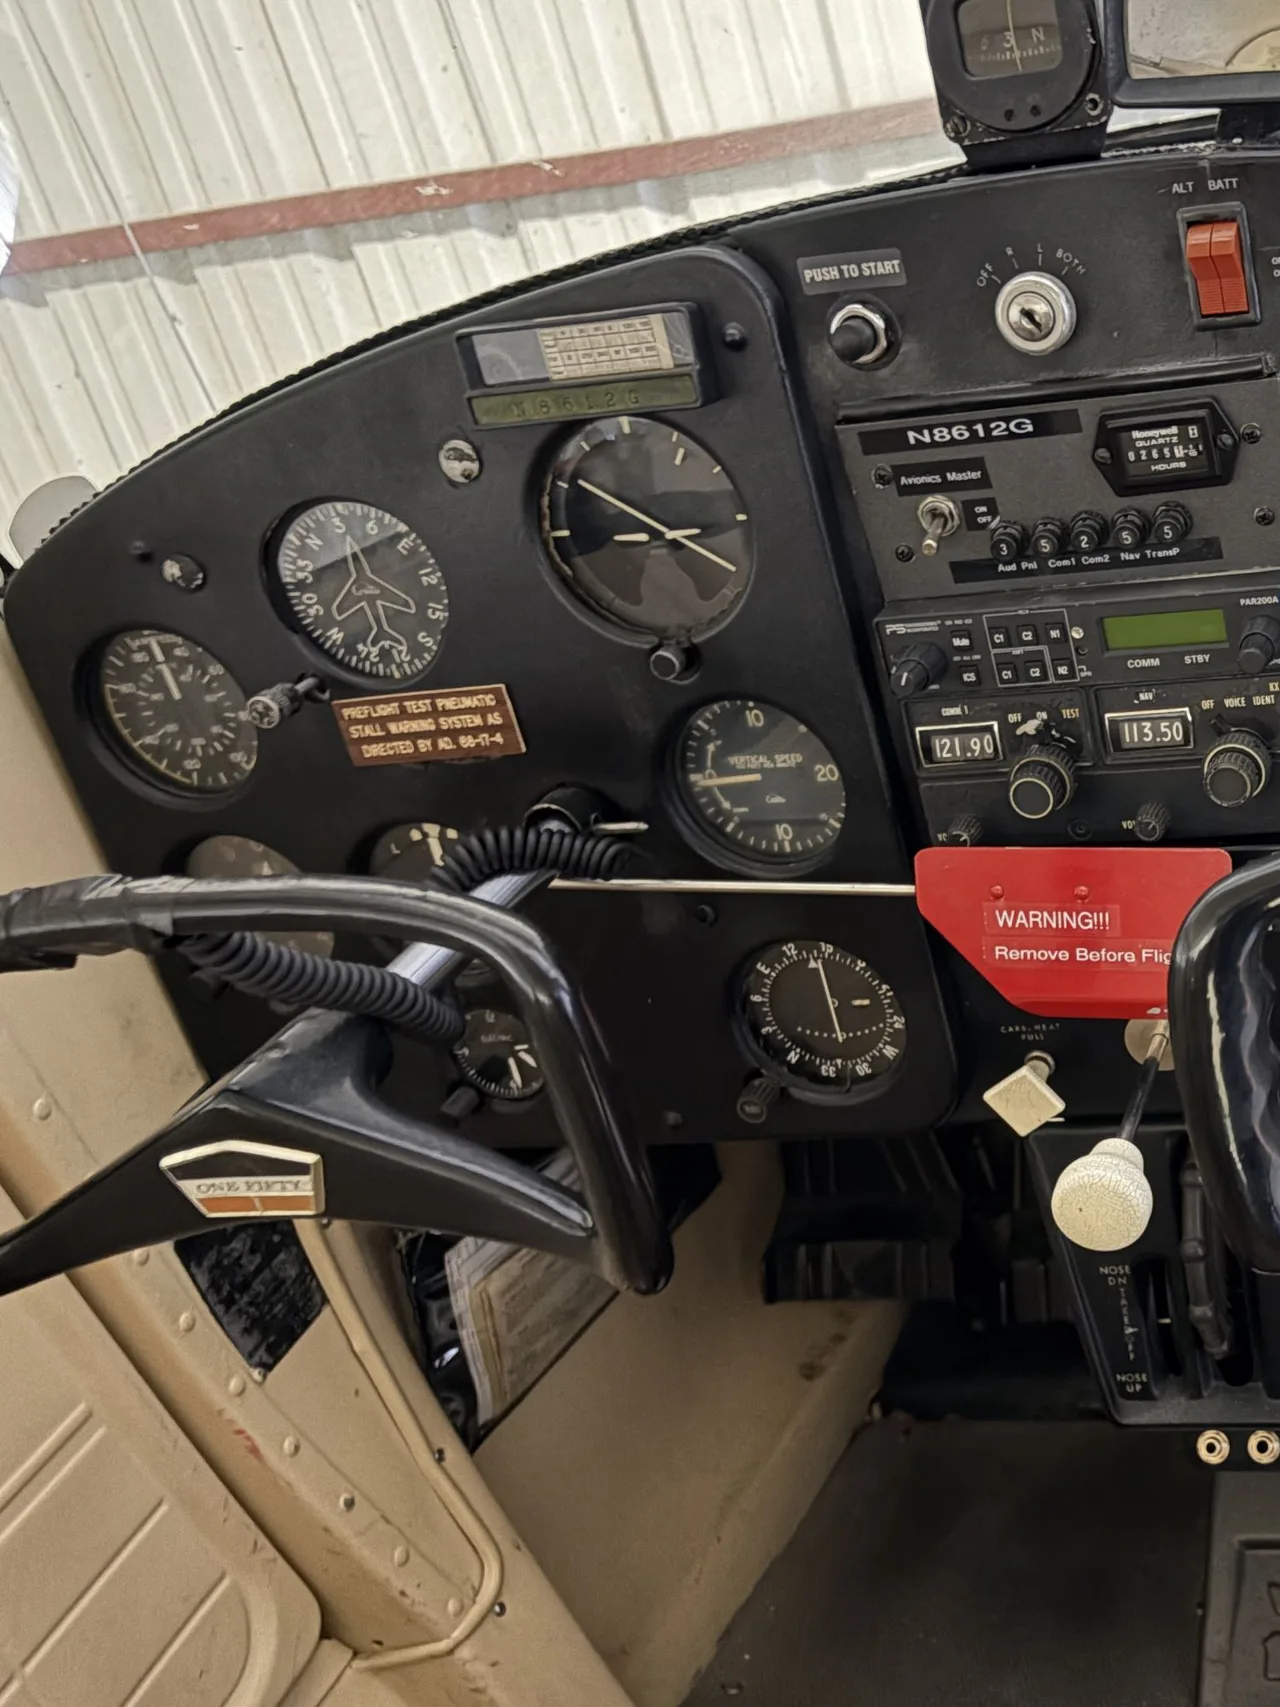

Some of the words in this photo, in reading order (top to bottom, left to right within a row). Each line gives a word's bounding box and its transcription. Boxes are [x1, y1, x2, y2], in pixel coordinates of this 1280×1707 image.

[1172, 182, 1194, 194] ALT
[1208, 178, 1239, 191] BATT
[1055, 248, 1087, 276] BOTH
[804, 266, 840, 283] PUSH
[841, 264, 860, 278] TO
[862, 260, 900, 277] START
[976, 262, 996, 288] OFF
[906, 418, 1034, 445] N8612G
[1132, 426, 1179, 440] Honeywell
[1135, 437, 1179, 448] QUARTZ
[1151, 461, 1187, 472] HOURS
[900, 474, 942, 486] Avionics
[946, 470, 982, 482] Master
[974, 505, 988, 514] ON
[977, 516, 992, 525] OFF
[998, 562, 1017, 573] Aud
[1021, 561, 1038, 571] Pnl
[1048, 558, 1076, 569] Com1
[1081, 555, 1110, 565] Com2
[1120, 551, 1140, 562] Nav
[1145, 547, 1180, 559] TransP
[1239, 596, 1279, 606] PAR200A
[952, 638, 970, 647] Mute
[994, 633, 1004, 644] C1
[1022, 631, 1033, 641] C2
[1050, 629, 1060, 639] N1
[1127, 658, 1160, 669] COMM
[1184, 654, 1210, 665] STBY
[963, 673, 976, 683] ICS
[1002, 670, 1012, 680] C1
[1030, 667, 1041, 677] C2
[1058, 665, 1069, 676] N2
[1269, 682, 1280, 692] KX
[1139, 692, 1153, 702] NAV
[1202, 700, 1214, 710] OFF
[1224, 697, 1246, 709] VOICE
[1253, 695, 1275, 706] IDENT
[341, 702, 399, 720] PREFLIGHT
[403, 699, 433, 714] TEST
[435, 694, 497, 711] PNEUMATIC
[745, 709, 765, 727] 10
[1008, 713, 1022, 723] OFF
[1037, 711, 1048, 721] ON
[1061, 708, 1080, 719] TEST
[349, 724, 386, 739] STALL
[387, 718, 436, 734] WARNING
[439, 714, 484, 730] SYSTEM
[487, 712, 503, 725] AS
[1125, 722, 1183, 743] 113.50
[361, 740, 414, 758] DIRECTED
[417, 739, 432, 752] BY
[935, 735, 994, 758] 121.90
[728, 754, 770, 765] VERTICAL
[774, 753, 803, 763] SPEED
[814, 764, 839, 782] 20
[775, 823, 793, 840] 10
[995, 910, 1110, 930] WARNING!!!
[995, 946, 1069, 961] Remove
[1076, 947, 1135, 963] Before
[196, 1181, 239, 1194] ONE
[244, 1179, 302, 1192] FIFTY
[1100, 1265, 1131, 1275] NOSE
[1108, 1277, 1127, 1285] DN
[1116, 1373, 1148, 1382] NOSE
[1126, 1384, 1142, 1393] UP
